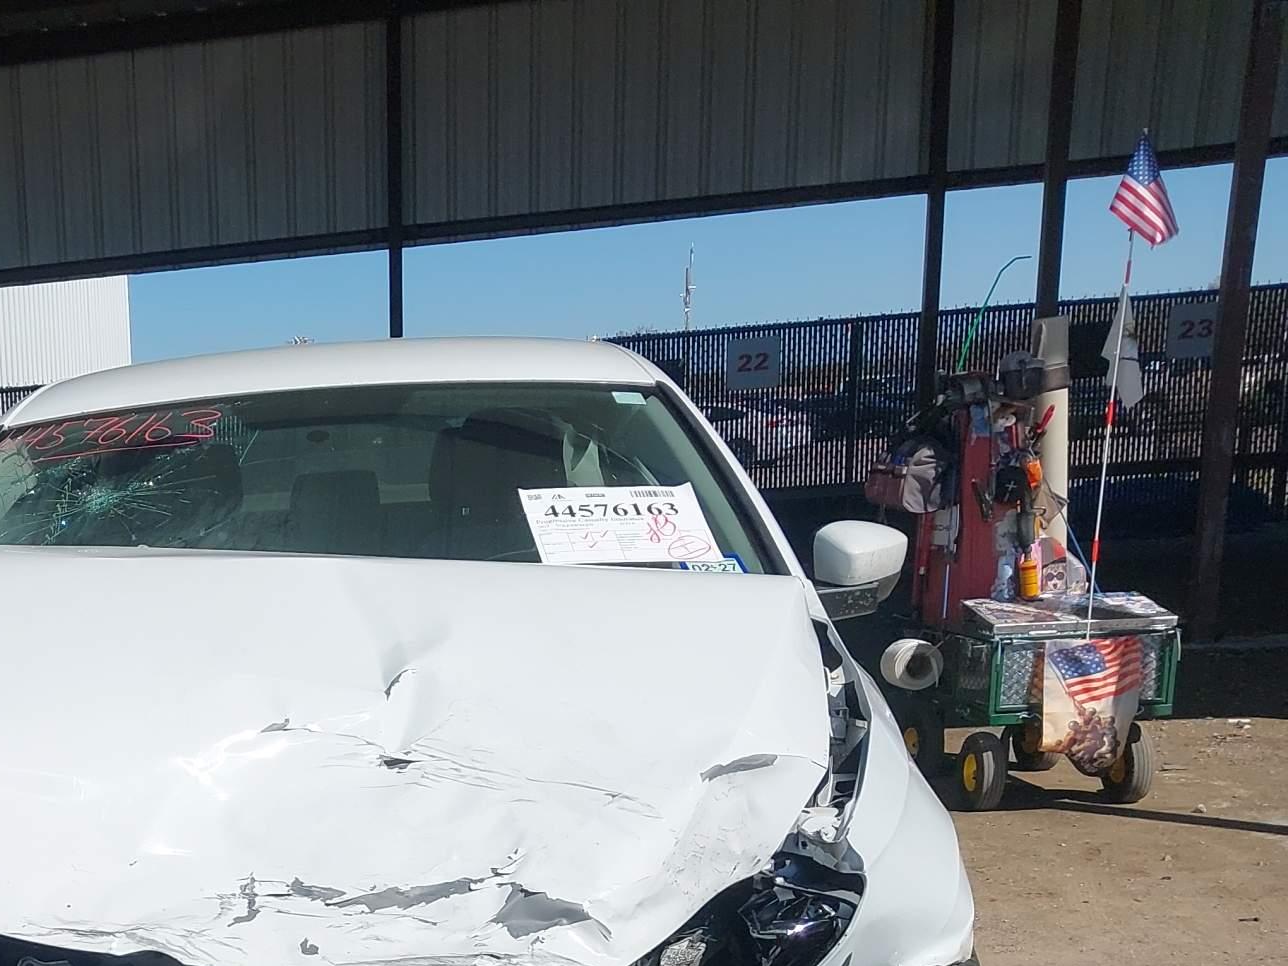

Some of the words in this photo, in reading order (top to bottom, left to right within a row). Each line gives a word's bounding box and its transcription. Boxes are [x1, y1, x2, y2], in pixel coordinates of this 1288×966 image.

[1178, 319, 1213, 339] 23
[737, 352, 770, 373] 22
[543, 502, 679, 517] 44576163
